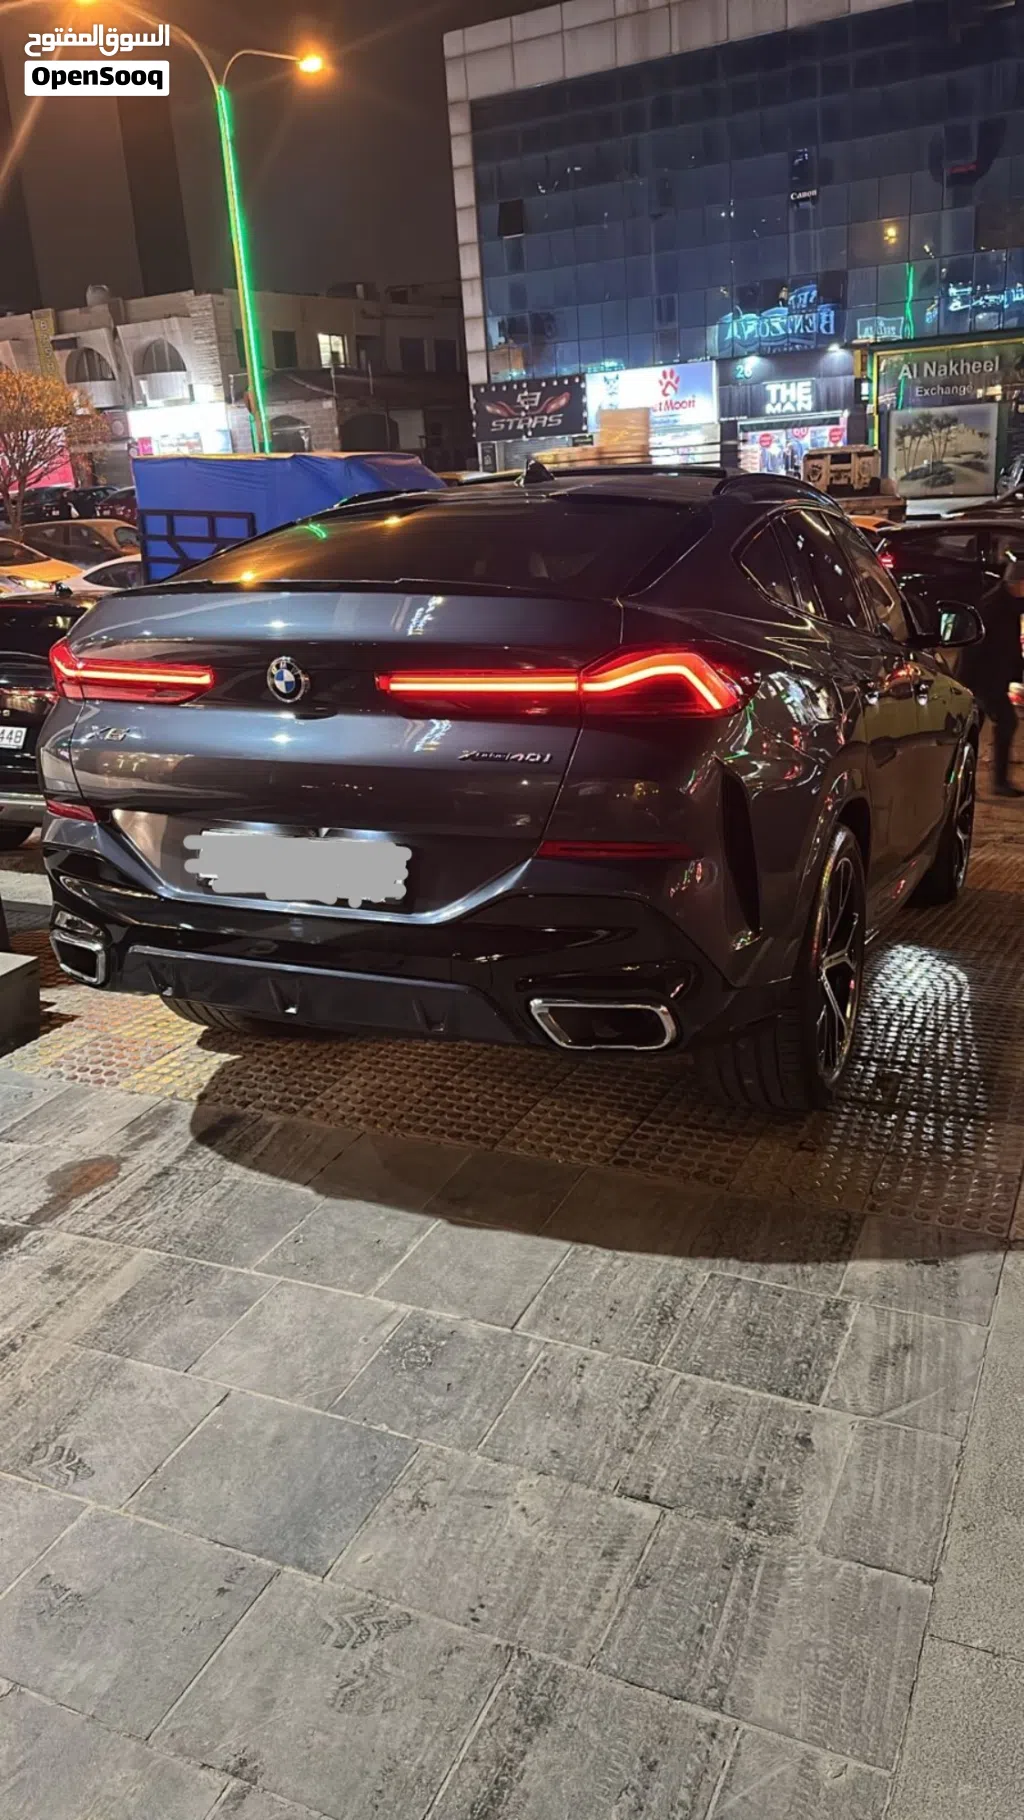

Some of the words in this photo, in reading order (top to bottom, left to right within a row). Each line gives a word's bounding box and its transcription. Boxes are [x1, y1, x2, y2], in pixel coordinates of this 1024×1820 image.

[735, 364, 753, 379] 26
[898, 363, 917, 380] Al
[923, 356, 1000, 378] Nakheel
[765, 381, 812, 404] THE
[915, 383, 974, 397] Exchange
[765, 400, 812, 414] MAN
